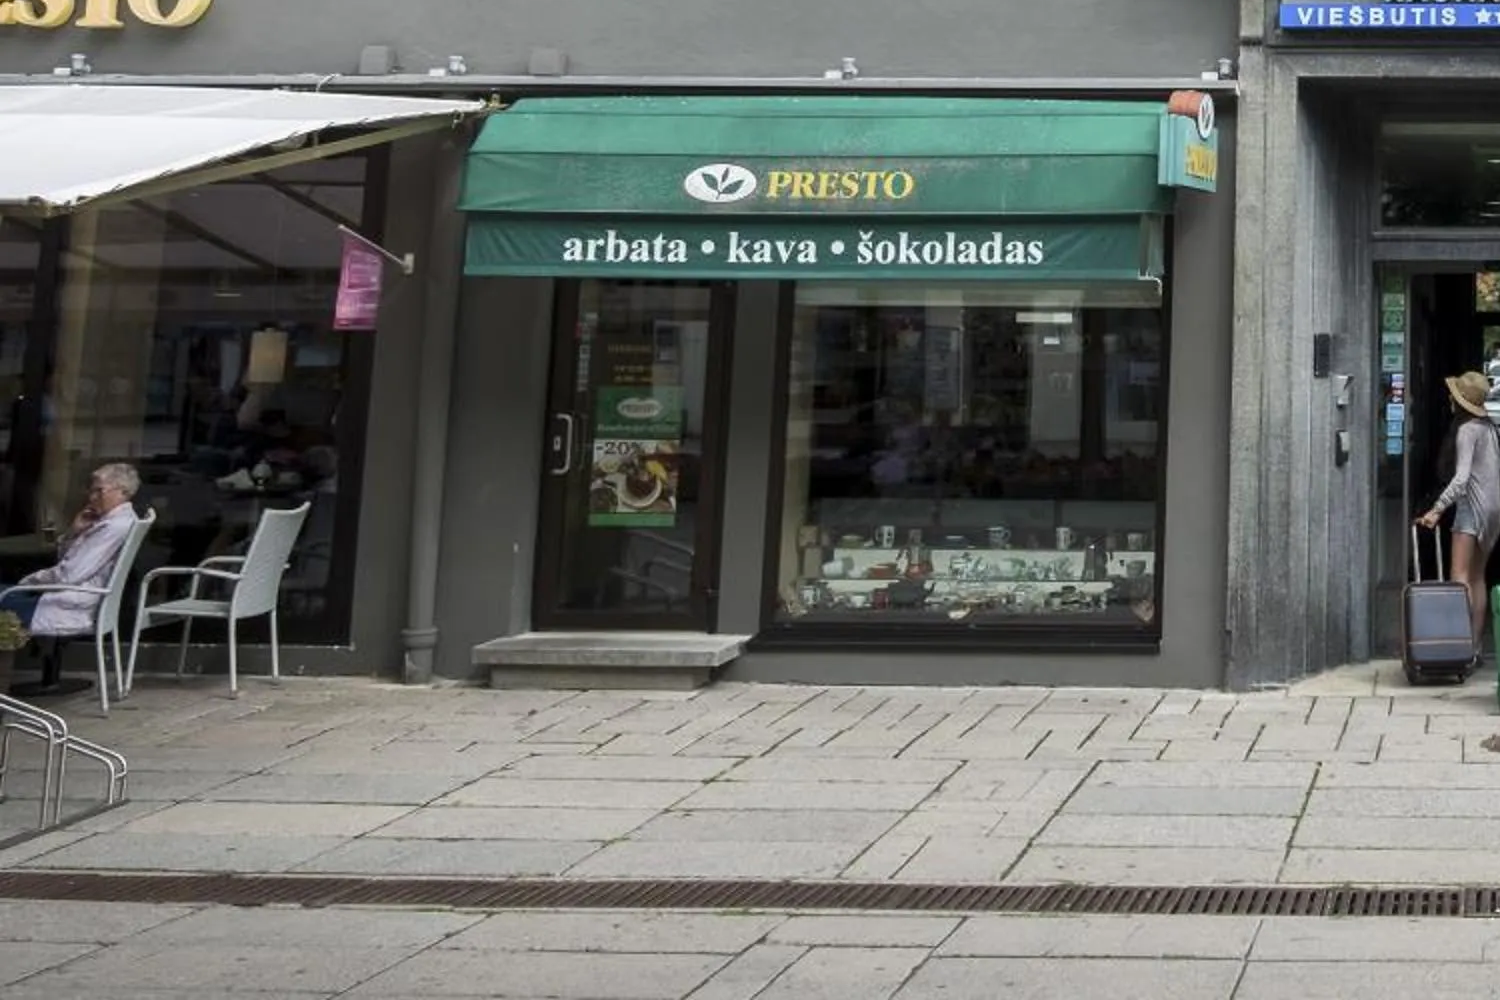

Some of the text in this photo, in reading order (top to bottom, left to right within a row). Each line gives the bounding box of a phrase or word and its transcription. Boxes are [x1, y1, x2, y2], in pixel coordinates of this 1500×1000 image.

[1297, 5, 1456, 26] VIEŠBUTIS
[766, 171, 915, 200] PRESTO
[562, 229, 1044, 265] arbata kava šokoladas
